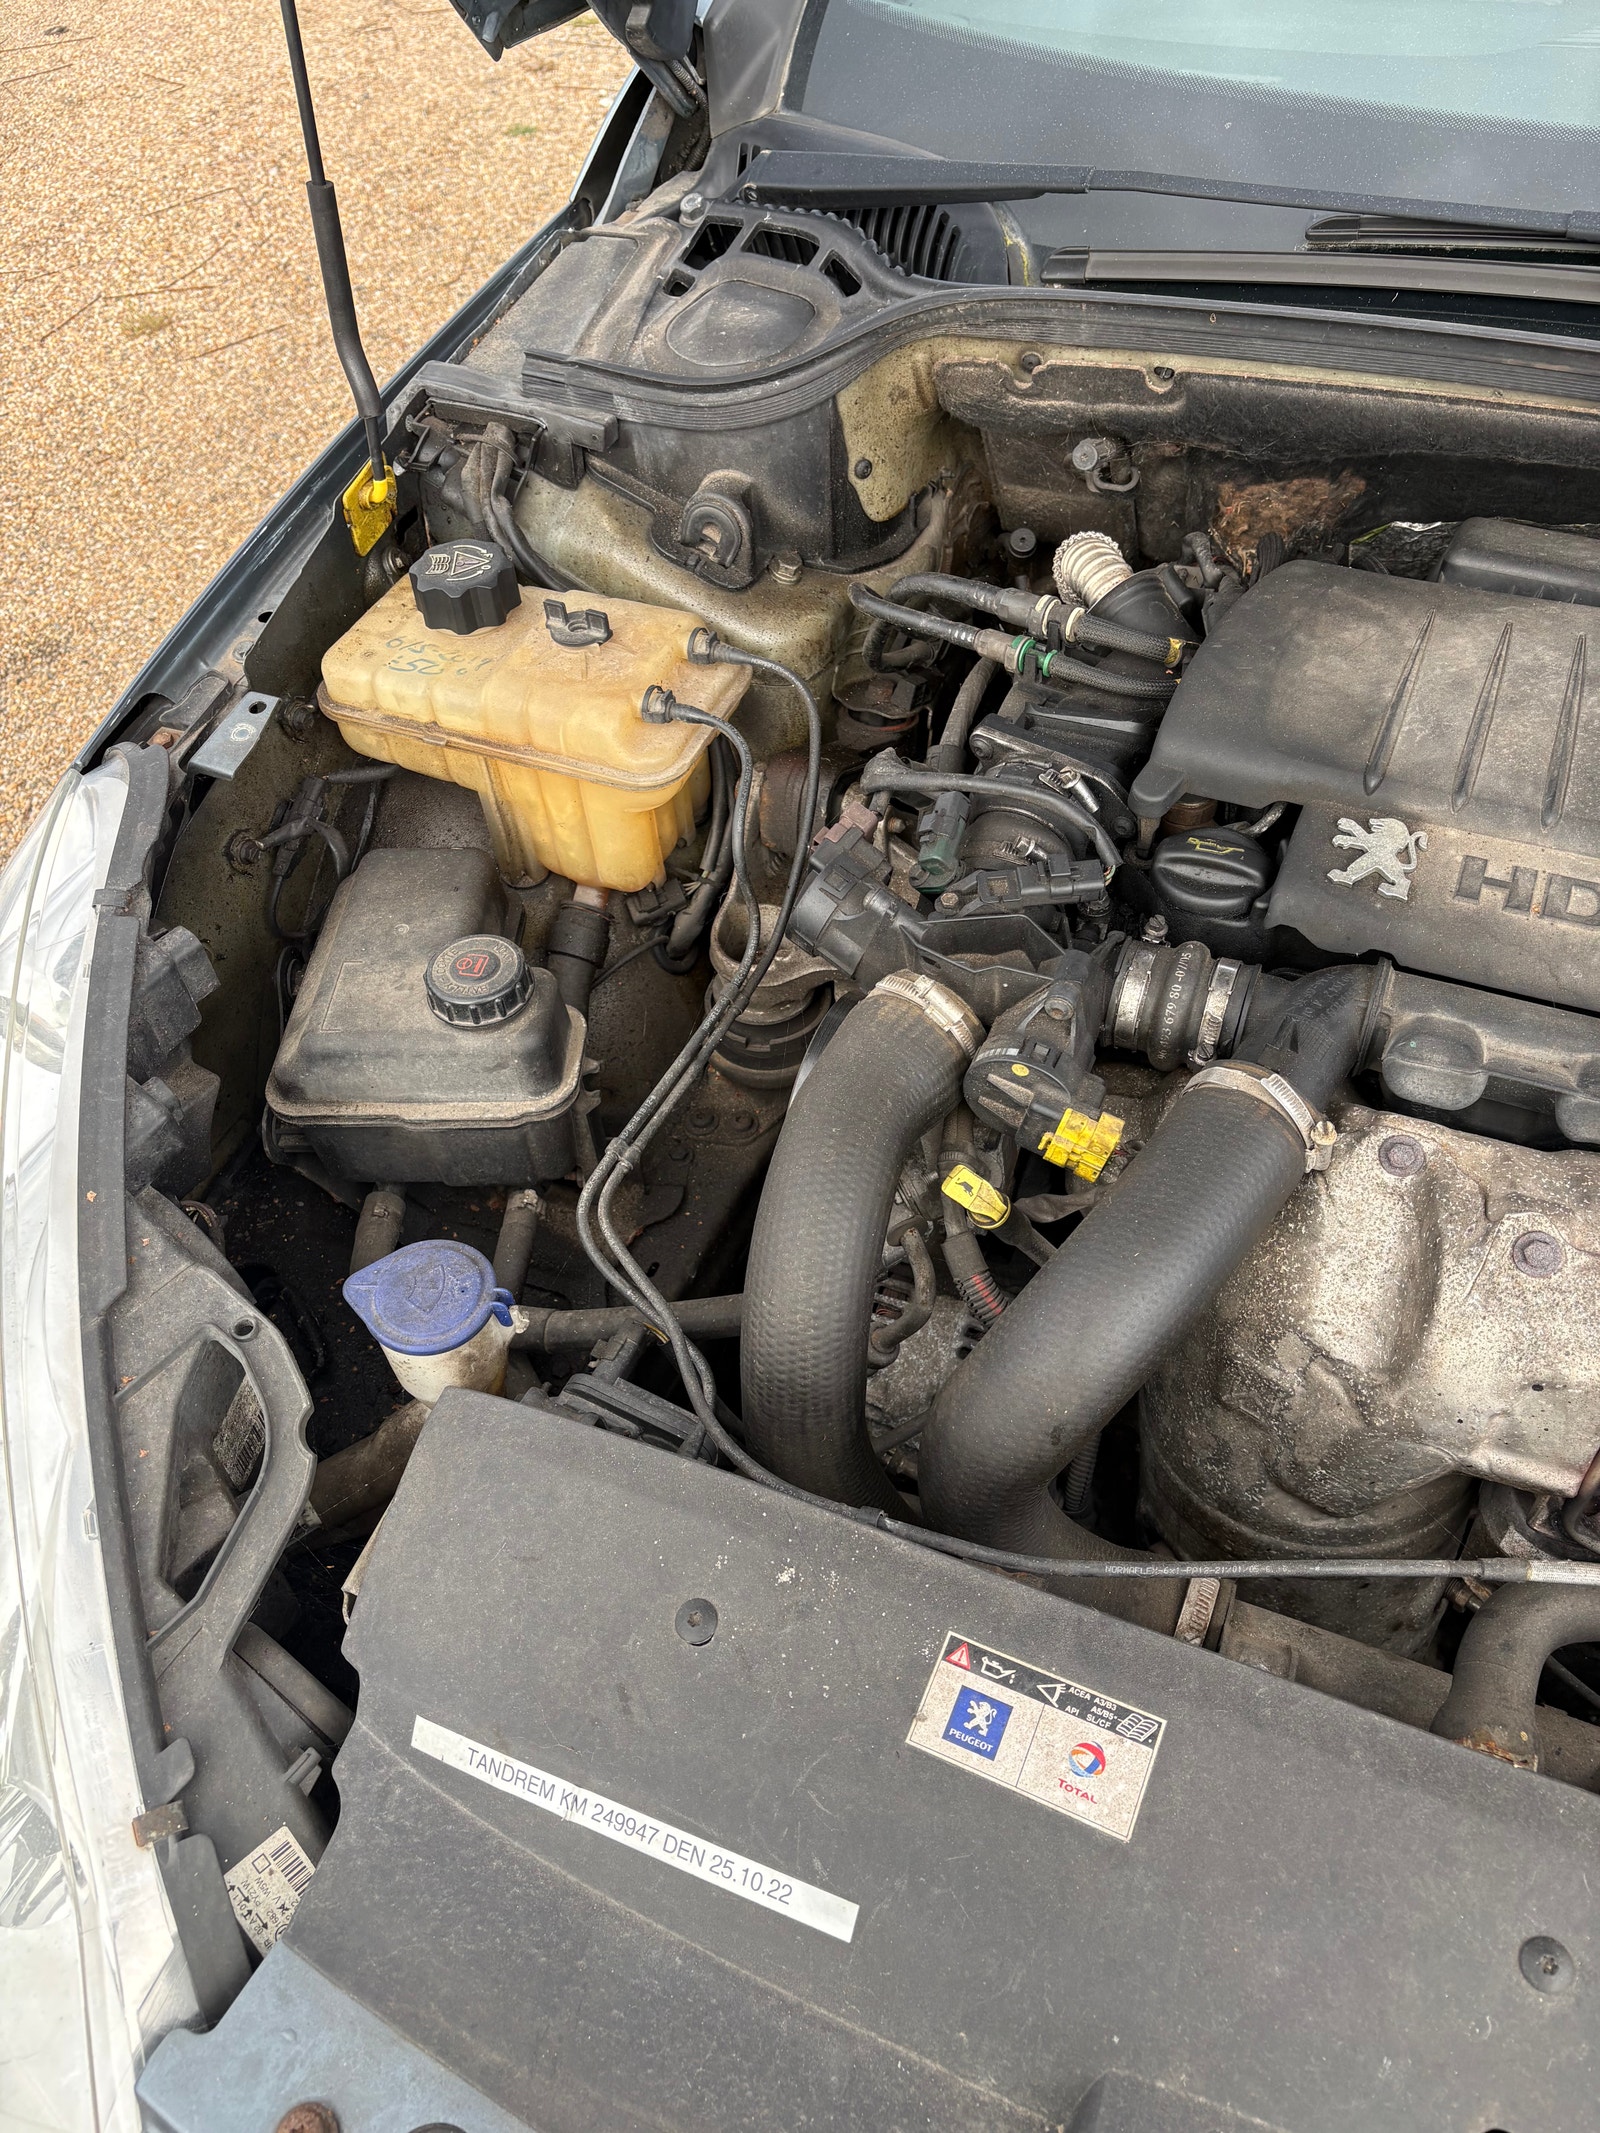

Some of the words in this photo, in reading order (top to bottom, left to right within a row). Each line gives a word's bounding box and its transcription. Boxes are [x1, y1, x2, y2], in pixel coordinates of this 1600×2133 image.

[1169, 984, 1183, 1000] 80
[1163, 1002, 1177, 1025] 679
[1068, 1686, 1091, 1701] ACEA
[1093, 1697, 1117, 1711] A3/B3
[1065, 1705, 1080, 1717] API
[1086, 1713, 1112, 1729] SL/CF
[949, 1728, 993, 1753] PEUGEOT
[1058, 1778, 1098, 1805] TOTAL
[468, 1747, 556, 1802] TANDREM
[559, 1788, 588, 1816] KM
[591, 1803, 660, 1845] 249947
[662, 1833, 706, 1868] DEN
[709, 1854, 793, 1905] 25.10.22
[241, 1879, 261, 1907] PY21W
[255, 1876, 271, 1898] W5W
